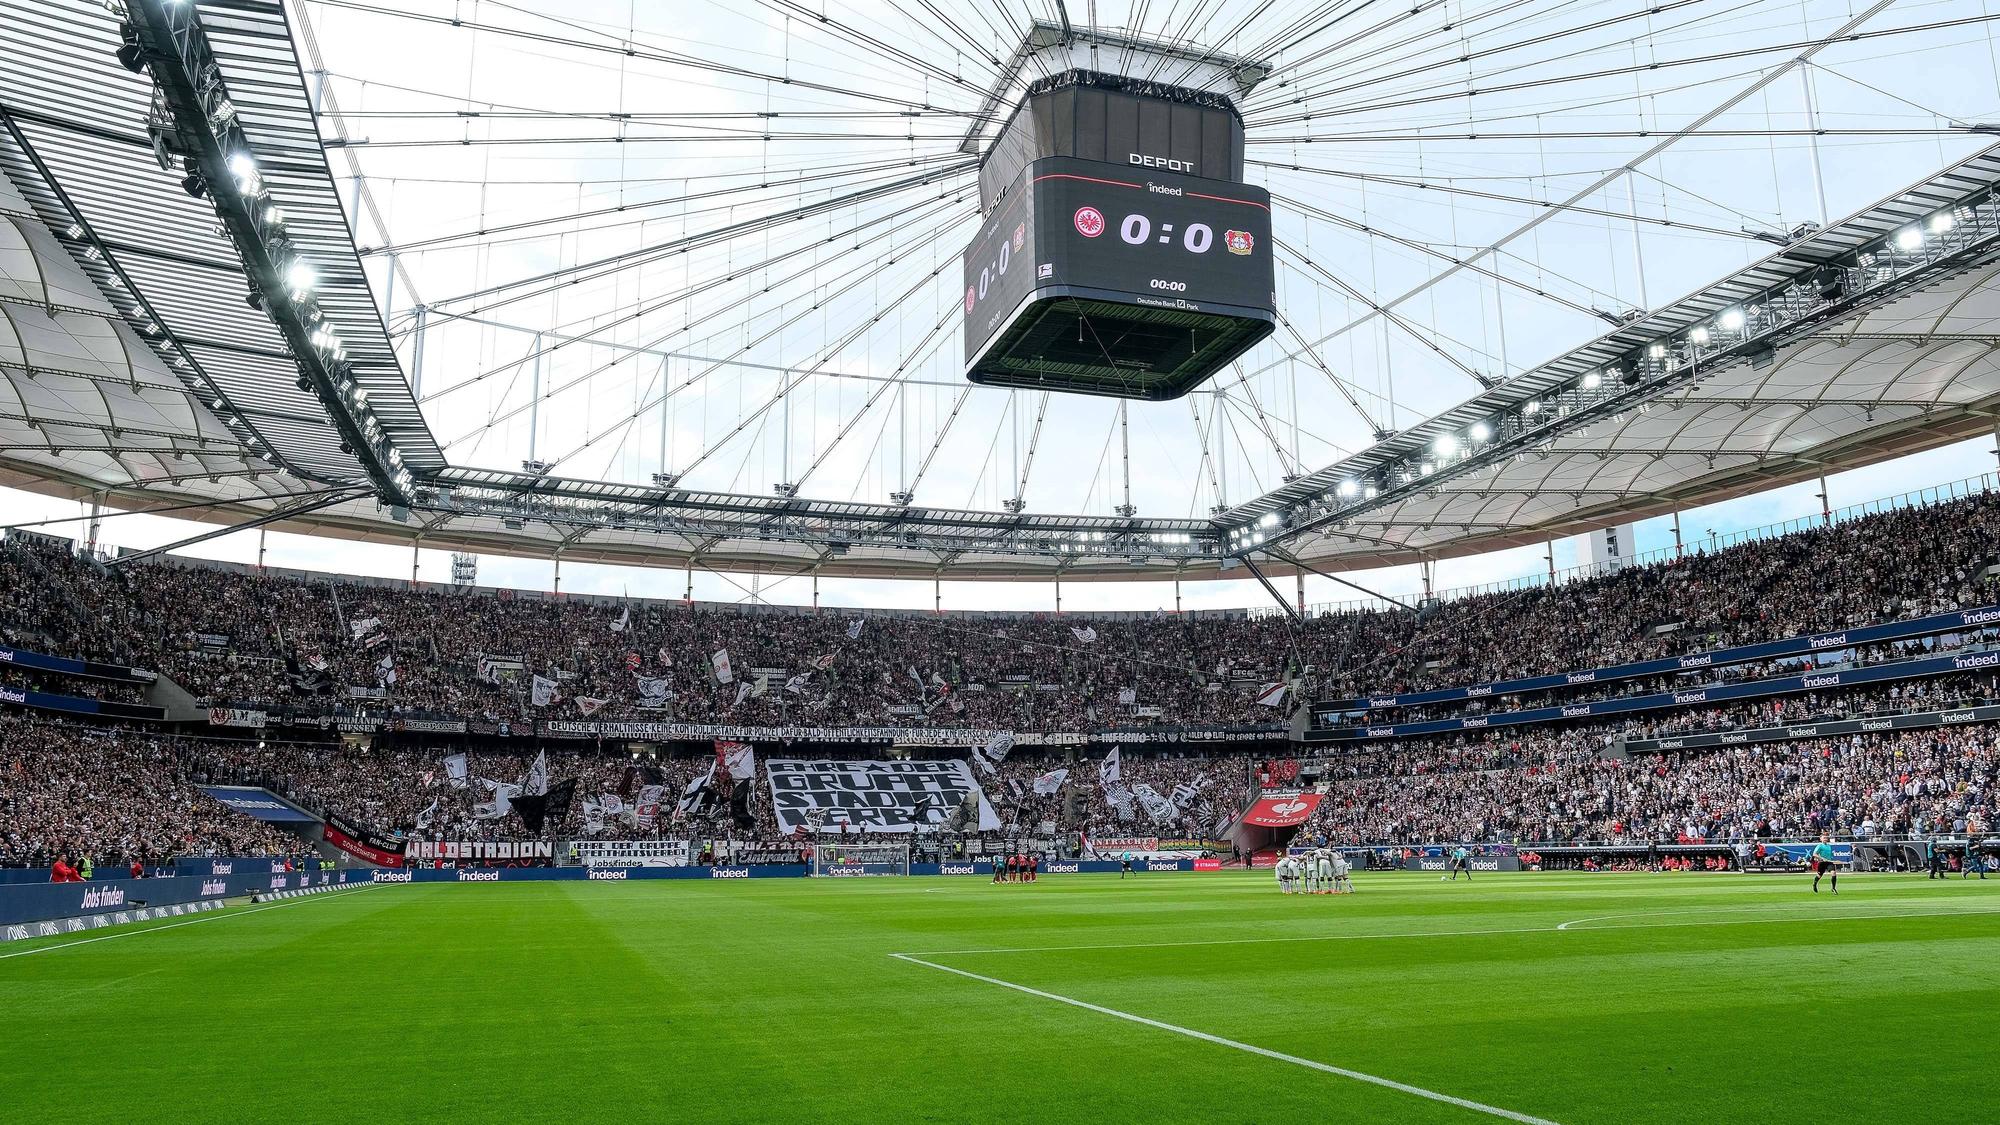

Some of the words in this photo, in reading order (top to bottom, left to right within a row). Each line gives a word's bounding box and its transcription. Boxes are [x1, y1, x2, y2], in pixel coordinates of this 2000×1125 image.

[1129, 153, 1194, 173] DEPOT
[1146, 182, 1182, 197] indeed
[1150, 278, 1186, 291] 00:00
[1137, 297, 1163, 307] Deutsche
[1162, 300, 1177, 308] Bank
[1960, 611, 2000, 625] indee
[1808, 633, 1847, 648] indeed
[1678, 654, 1712, 668] indeed
[1951, 652, 1999, 669] indeed
[1566, 672, 1595, 684] indeed
[1801, 673, 1840, 688] indeed
[1466, 686, 1492, 697] indeed
[1672, 691, 1706, 704] indeed
[1368, 697, 1397, 708] indeed
[1561, 706, 1590, 717] indeed
[1939, 711, 1976, 724] indeed
[294, 717, 319, 725] united
[331, 716, 384, 725] COMMANDO
[1462, 717, 1488, 728] indeed
[1860, 719, 1892, 731] indeed
[337, 724, 377, 733] GIESSEN
[551, 722, 592, 732] DEUTSCHE
[1366, 726, 1395, 737] indeed
[1787, 727, 1817, 738] indeed
[1657, 739, 1682, 749] indeed
[1720, 733, 1748, 744] indeed
[768, 763, 859, 773] EHRE
[890, 762, 962, 772] DER
[773, 774, 972, 791] GRUPPE
[1255, 816, 1306, 825] STRAUSS
[330, 817, 359, 838] EINTRACHT
[369, 838, 398, 851] FAN-CLUB
[405, 842, 553, 858] WALDSTADION
[577, 842, 605, 850] EHRE
[612, 842, 633, 850] DER
[640, 841, 681, 850] GRUPPE
[592, 860, 612, 868] Jobs
[973, 855, 991, 863] Jobs
[1420, 858, 1446, 870] indeed
[1470, 858, 1498, 870] indeed
[212, 859, 232, 875] indeed
[939, 864, 974, 875] indeed
[1046, 863, 1079, 873] indeed
[1147, 860, 1178, 871] indeed
[371, 869, 412, 882] indeed
[456, 868, 499, 881] indeed
[586, 868, 627, 880] indeed
[710, 867, 749, 878] indeed
[201, 880, 213, 896] Jobs
[212, 878, 226, 895] finden
[81, 887, 101, 909] Jobs
[101, 885, 124, 907] finden
